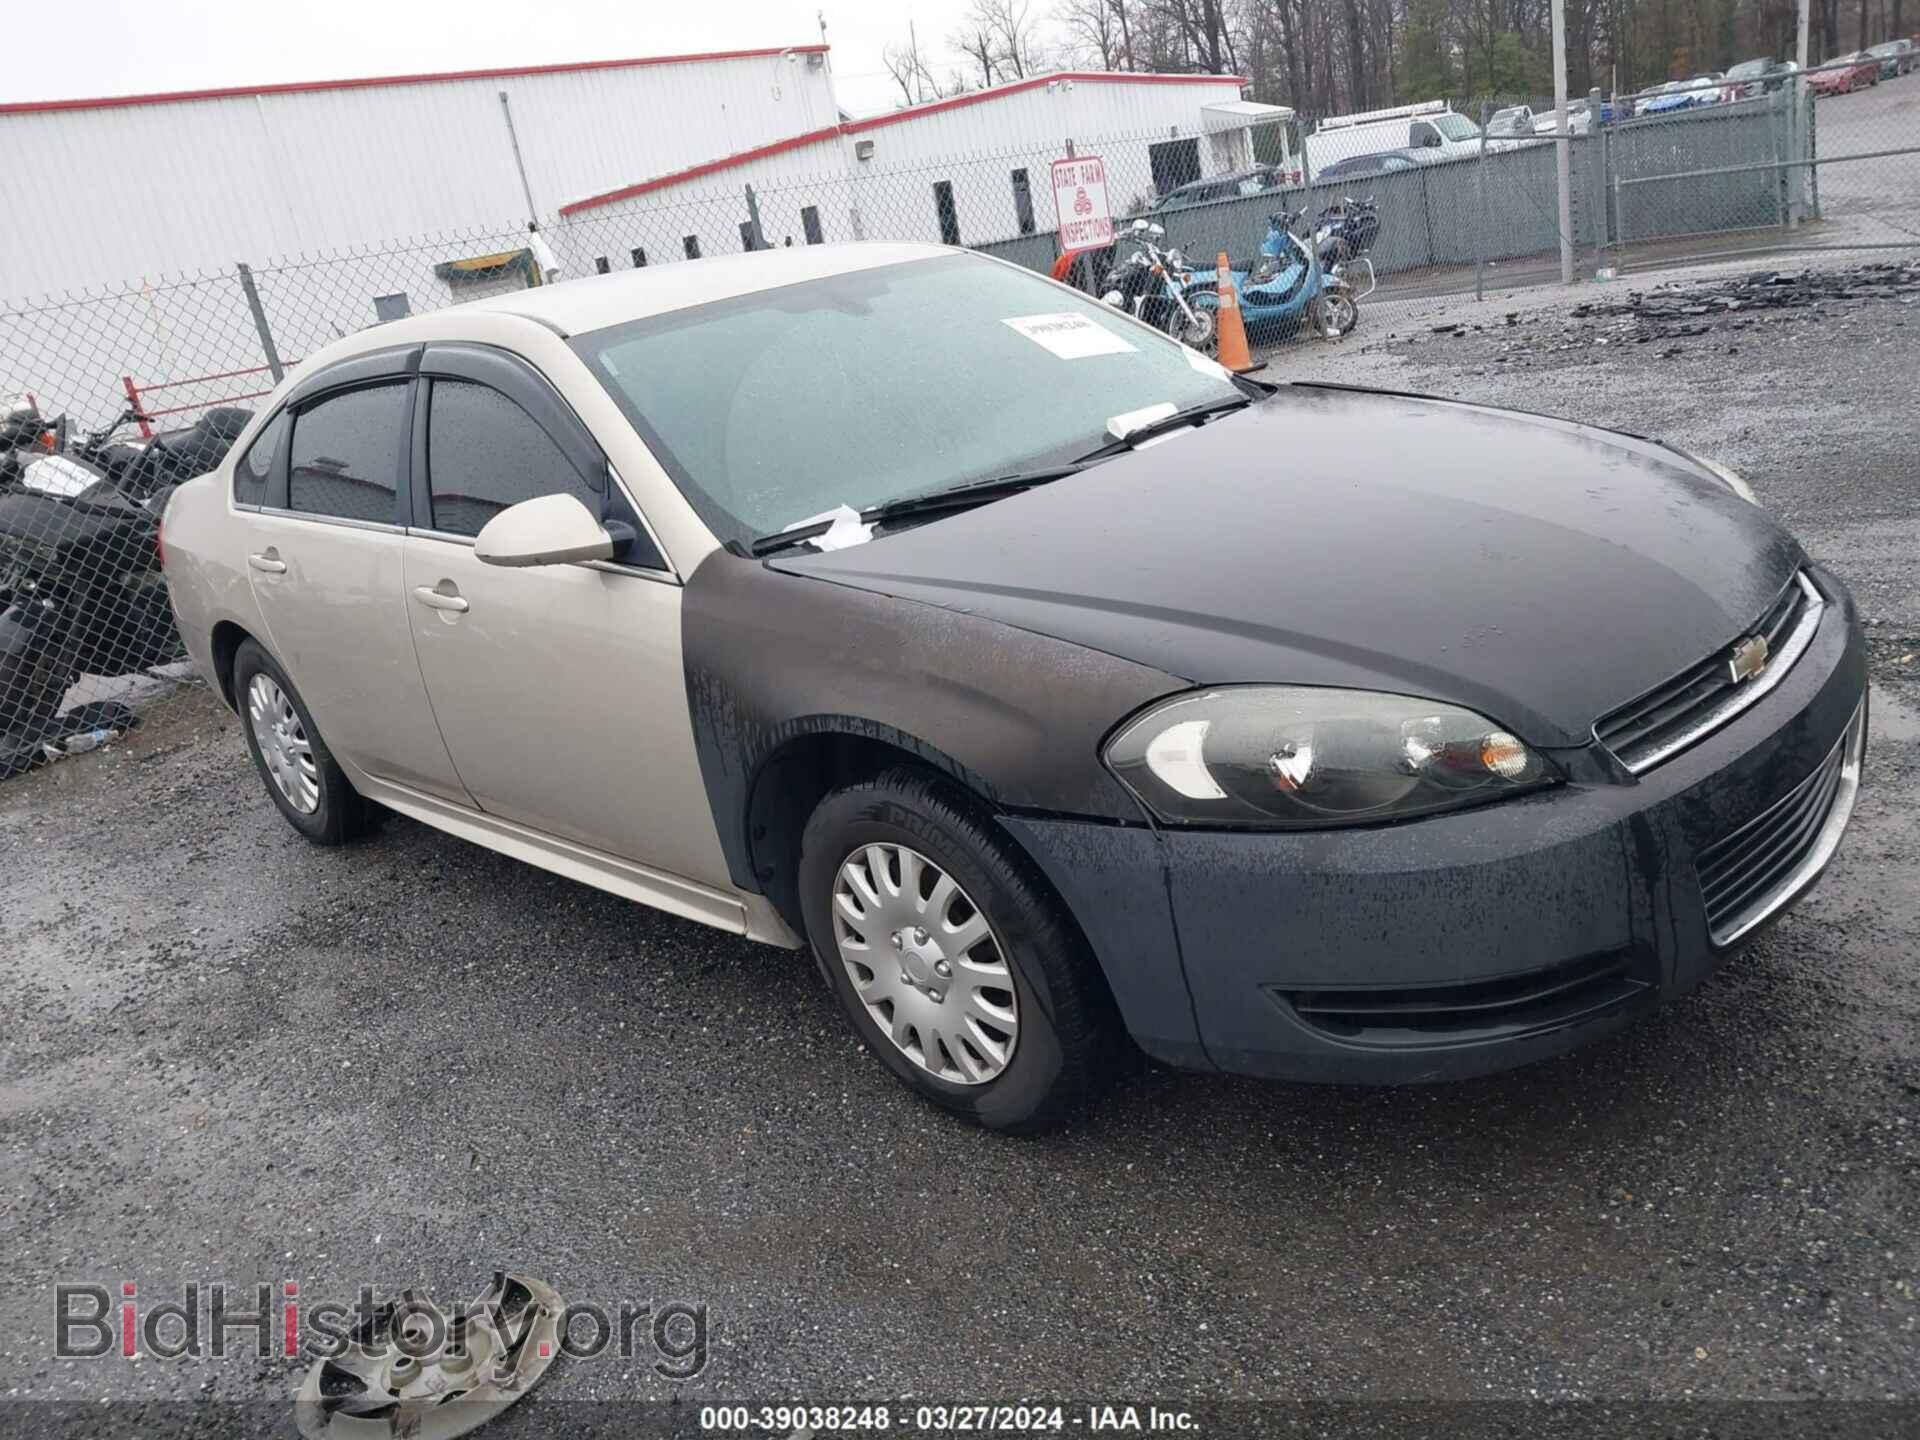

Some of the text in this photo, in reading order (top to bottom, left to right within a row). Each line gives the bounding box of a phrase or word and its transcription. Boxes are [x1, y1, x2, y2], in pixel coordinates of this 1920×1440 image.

[1055, 163, 1103, 188] STATE FARM
[1060, 216, 1110, 243] INSPECTIONS
